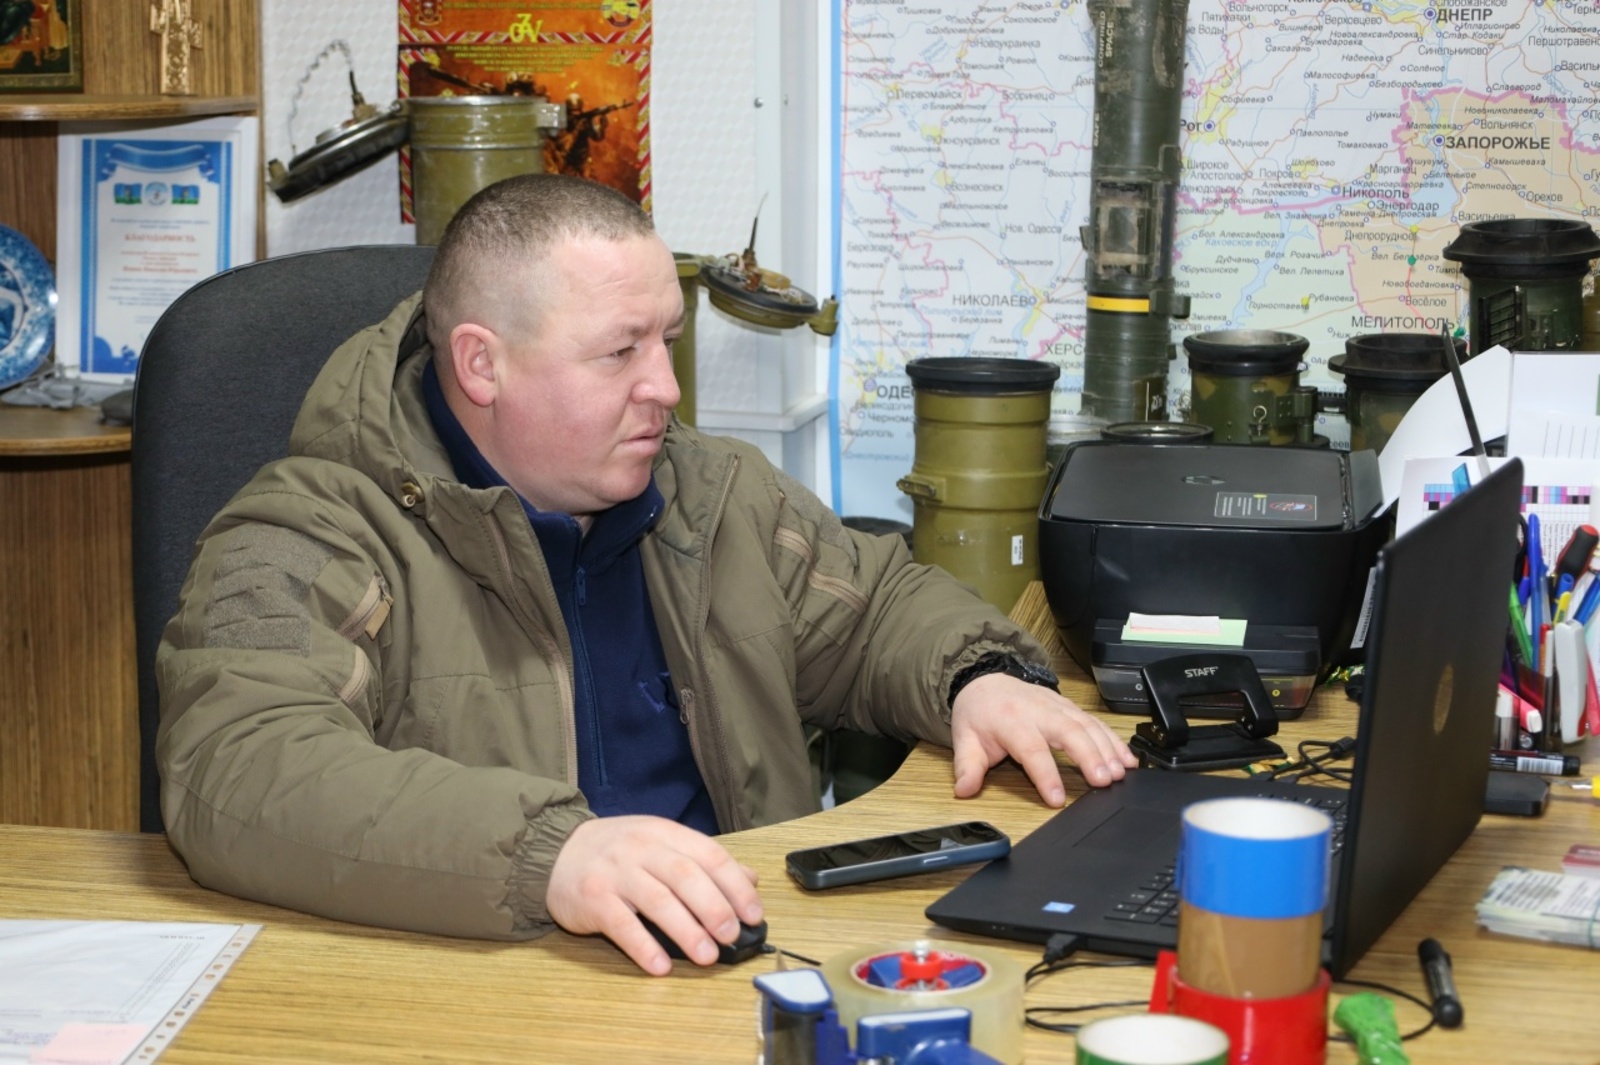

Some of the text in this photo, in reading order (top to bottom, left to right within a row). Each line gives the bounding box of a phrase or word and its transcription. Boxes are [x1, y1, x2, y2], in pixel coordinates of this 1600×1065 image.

[1229, 3, 1289, 13] Вольногорск
[1202, 12, 1251, 22] Пятихатки
[1325, 15, 1382, 25] Верховцево
[1436, 9, 1493, 23] ДНЕПР
[1198, 25, 1225, 36] Воды
[1330, 30, 1418, 39] Новоалександровка
[1543, 26, 1597, 34] Николаевка
[976, 38, 1041, 49] Новоукраинка
[1418, 46, 1488, 56] Синельниково
[1342, 54, 1384, 63] Надеевка
[1407, 64, 1445, 72] Солёное
[1310, 71, 1376, 81] Малософиевка
[1492, 83, 1542, 92] Славгород
[897, 89, 962, 100] Первомайск
[1002, 90, 1049, 101] Бобринец
[1222, 95, 1265, 104] Софиевка
[1370, 111, 1402, 120] Чумаки
[1464, 106, 1538, 115] Новониколаевка
[1481, 120, 1533, 130] Вольнянск
[1337, 141, 1382, 149] Томаковка
[1446, 137, 1550, 150] ЗАПОРОЖЬЕ
[1187, 161, 1229, 171] Широкое
[1488, 158, 1546, 166] Камышеваха
[1369, 164, 1417, 176] Марганец
[1429, 171, 1477, 179] Беленькое
[1342, 187, 1410, 199] Никополь
[1526, 193, 1563, 203] Орехов
[1376, 201, 1439, 213] Энергодар
[1457, 212, 1515, 221] Васильевка
[1028, 223, 1062, 234] Одесса
[1317, 220, 1364, 229] Днепровка
[1220, 231, 1285, 240] Александровка
[1205, 239, 1253, 247] Каховское
[1393, 253, 1439, 262] Белзёрка
[1301, 267, 1345, 276] Лепетиха
[1382, 280, 1454, 289] Новобогдановка
[953, 294, 1027, 307] НИКОЛАЕВ
[1309, 293, 1354, 303] Рубановка
[1406, 297, 1446, 307] Весёлое
[1351, 317, 1455, 330] МЕЛИТОПОЛЬ
[1184, 667, 1217, 678] STAFF
